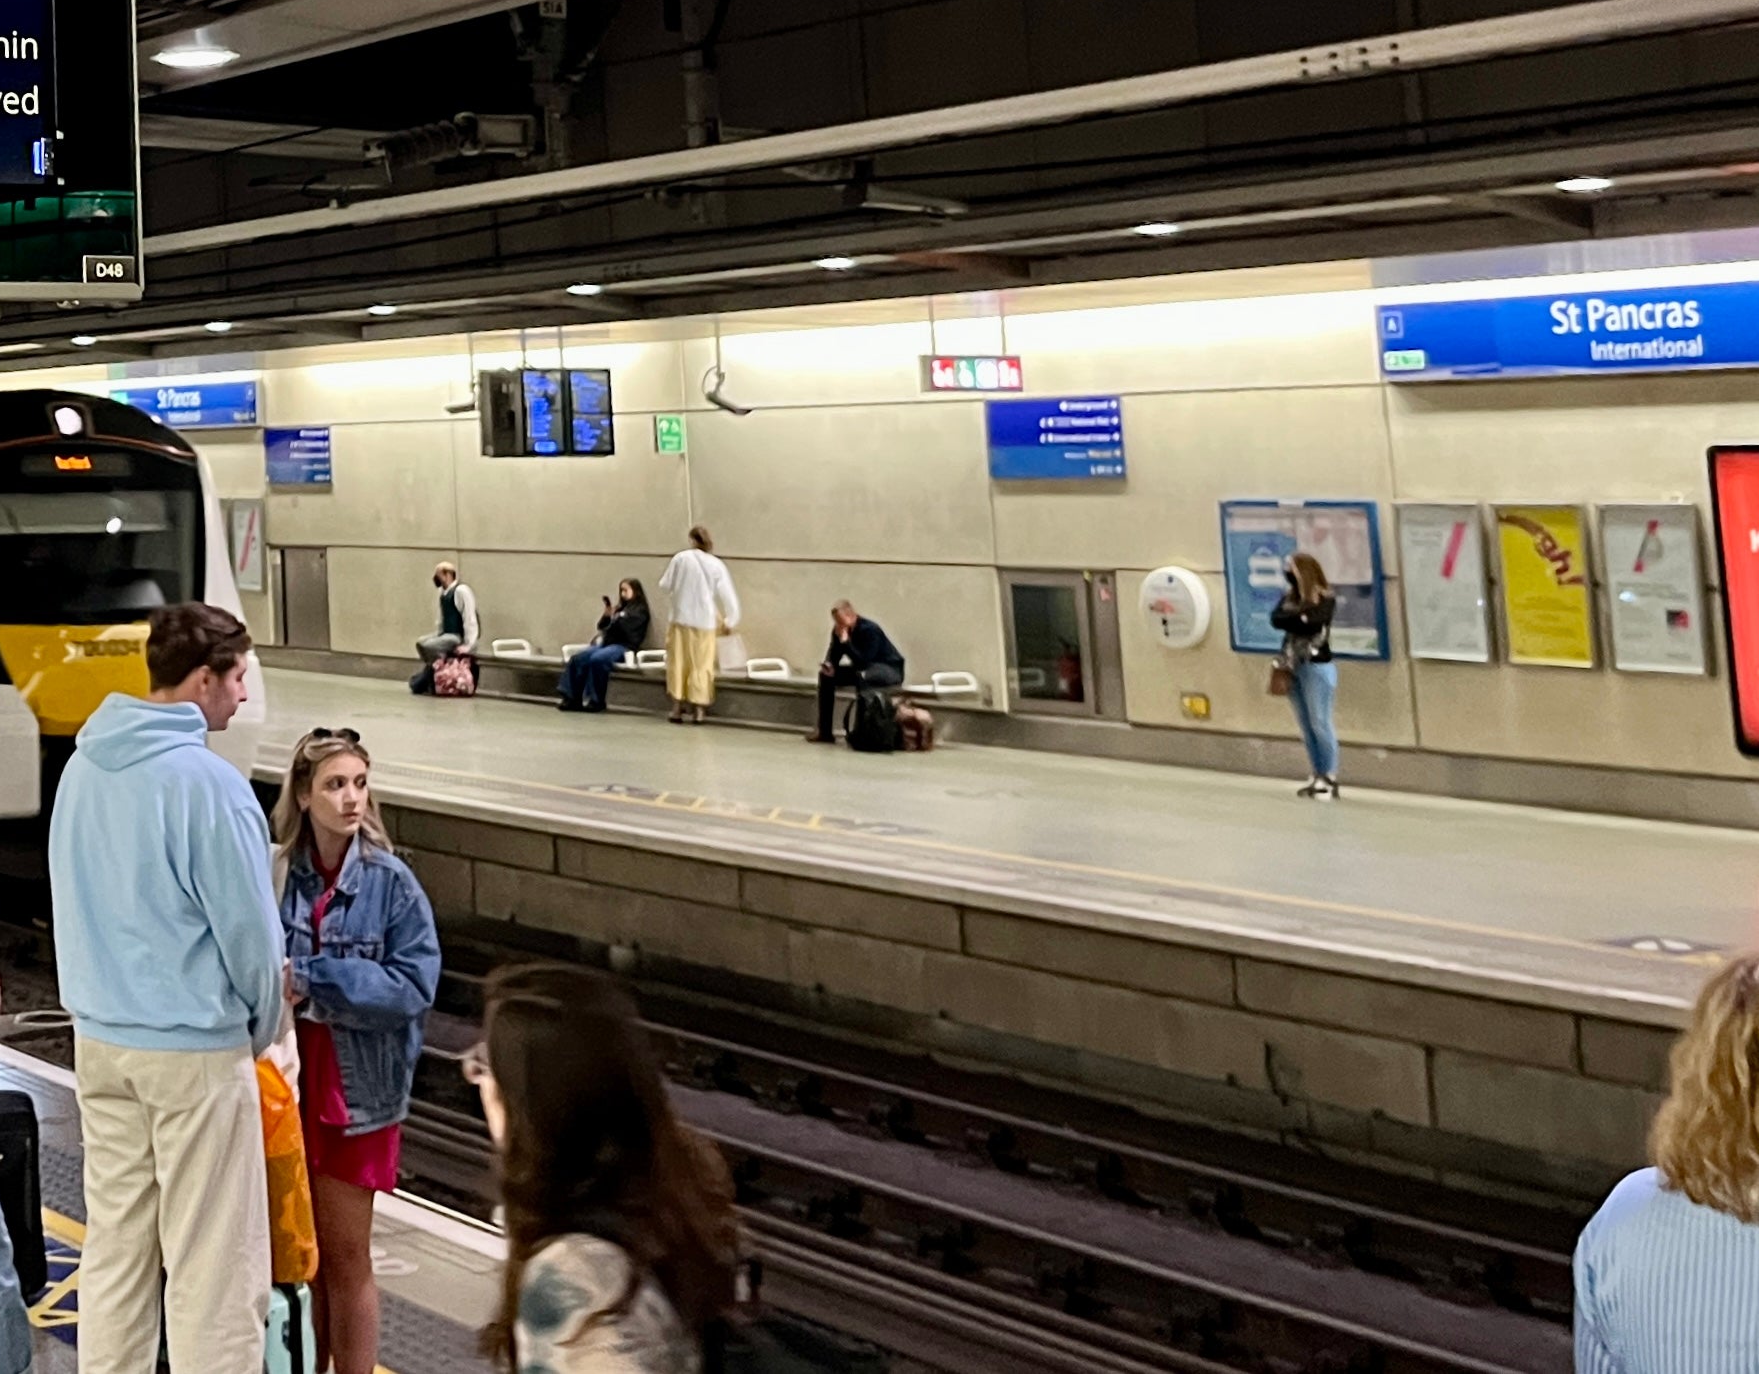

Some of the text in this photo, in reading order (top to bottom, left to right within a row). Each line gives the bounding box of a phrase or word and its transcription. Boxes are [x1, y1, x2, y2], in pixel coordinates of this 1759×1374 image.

[95, 262, 124, 278] D48
[1549, 297, 1701, 334] St Pancras
[1590, 334, 1704, 361] International
